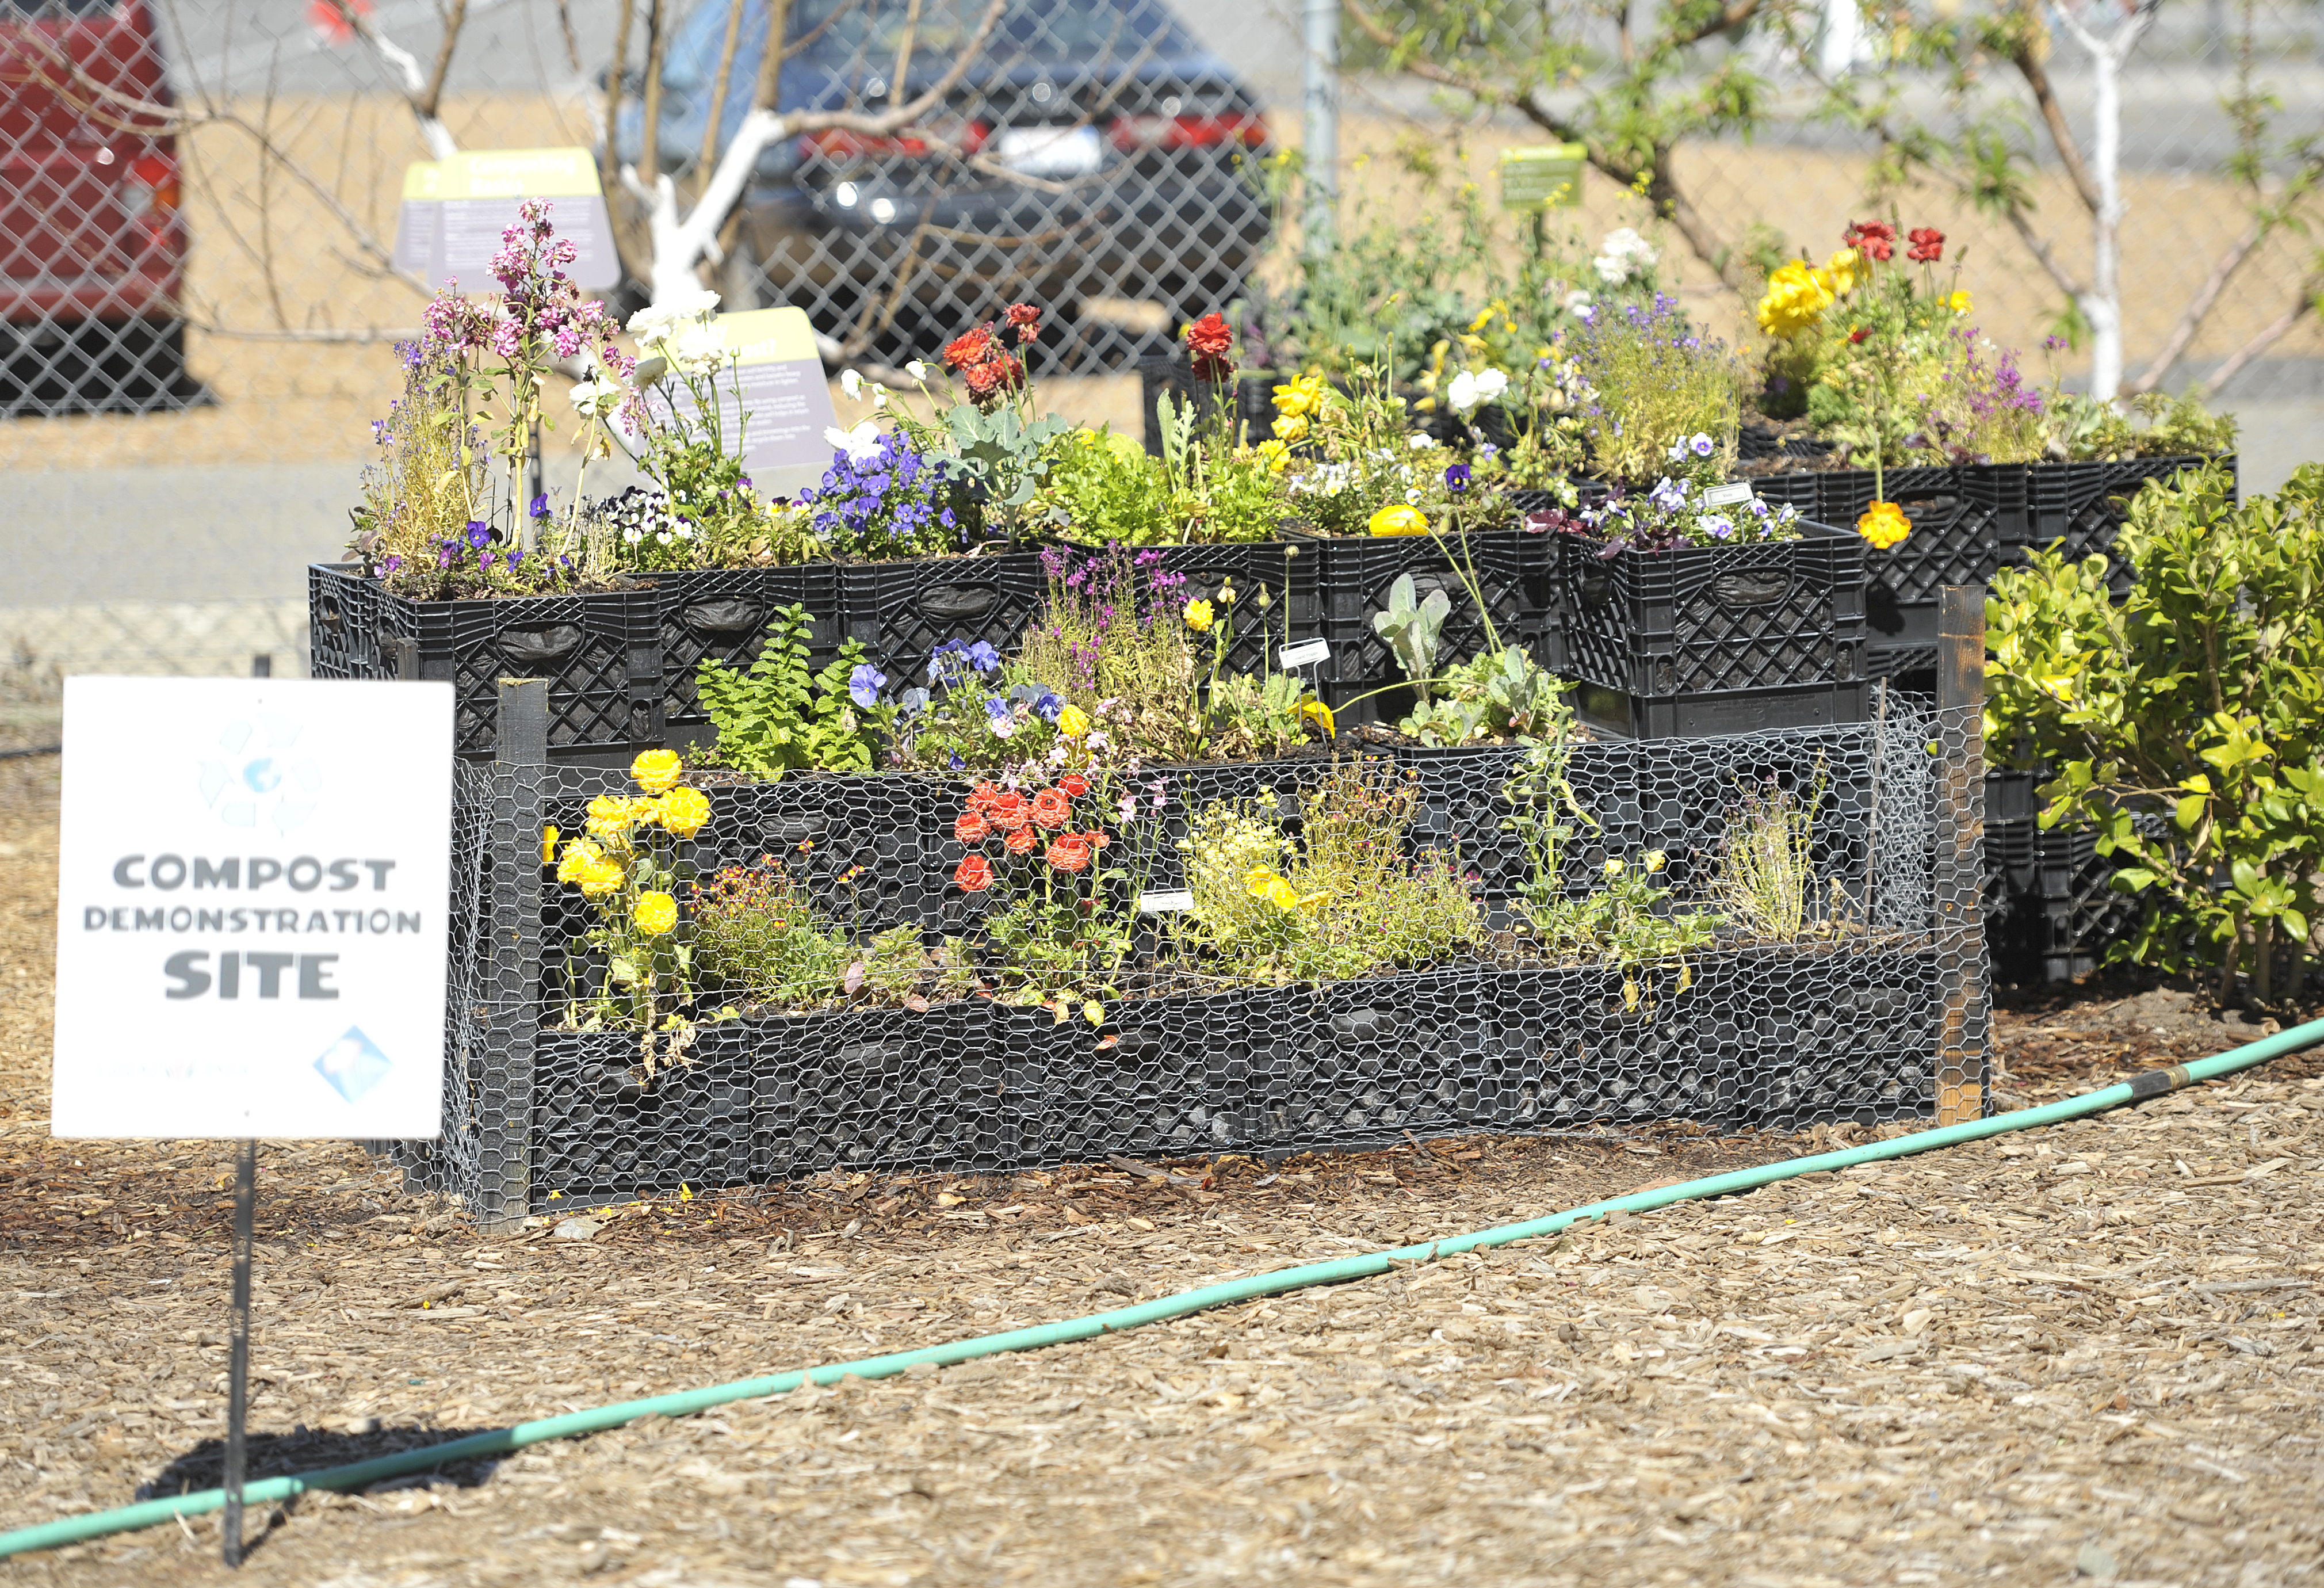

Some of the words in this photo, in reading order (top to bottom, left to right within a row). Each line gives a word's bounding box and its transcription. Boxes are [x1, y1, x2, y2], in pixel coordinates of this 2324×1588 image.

[468, 154, 577, 177] Composting
[469, 176, 525, 196] Basics
[112, 853, 396, 893] COMPOST
[83, 905, 421, 934] DEMONSTRATION
[163, 950, 339, 999] SITE
